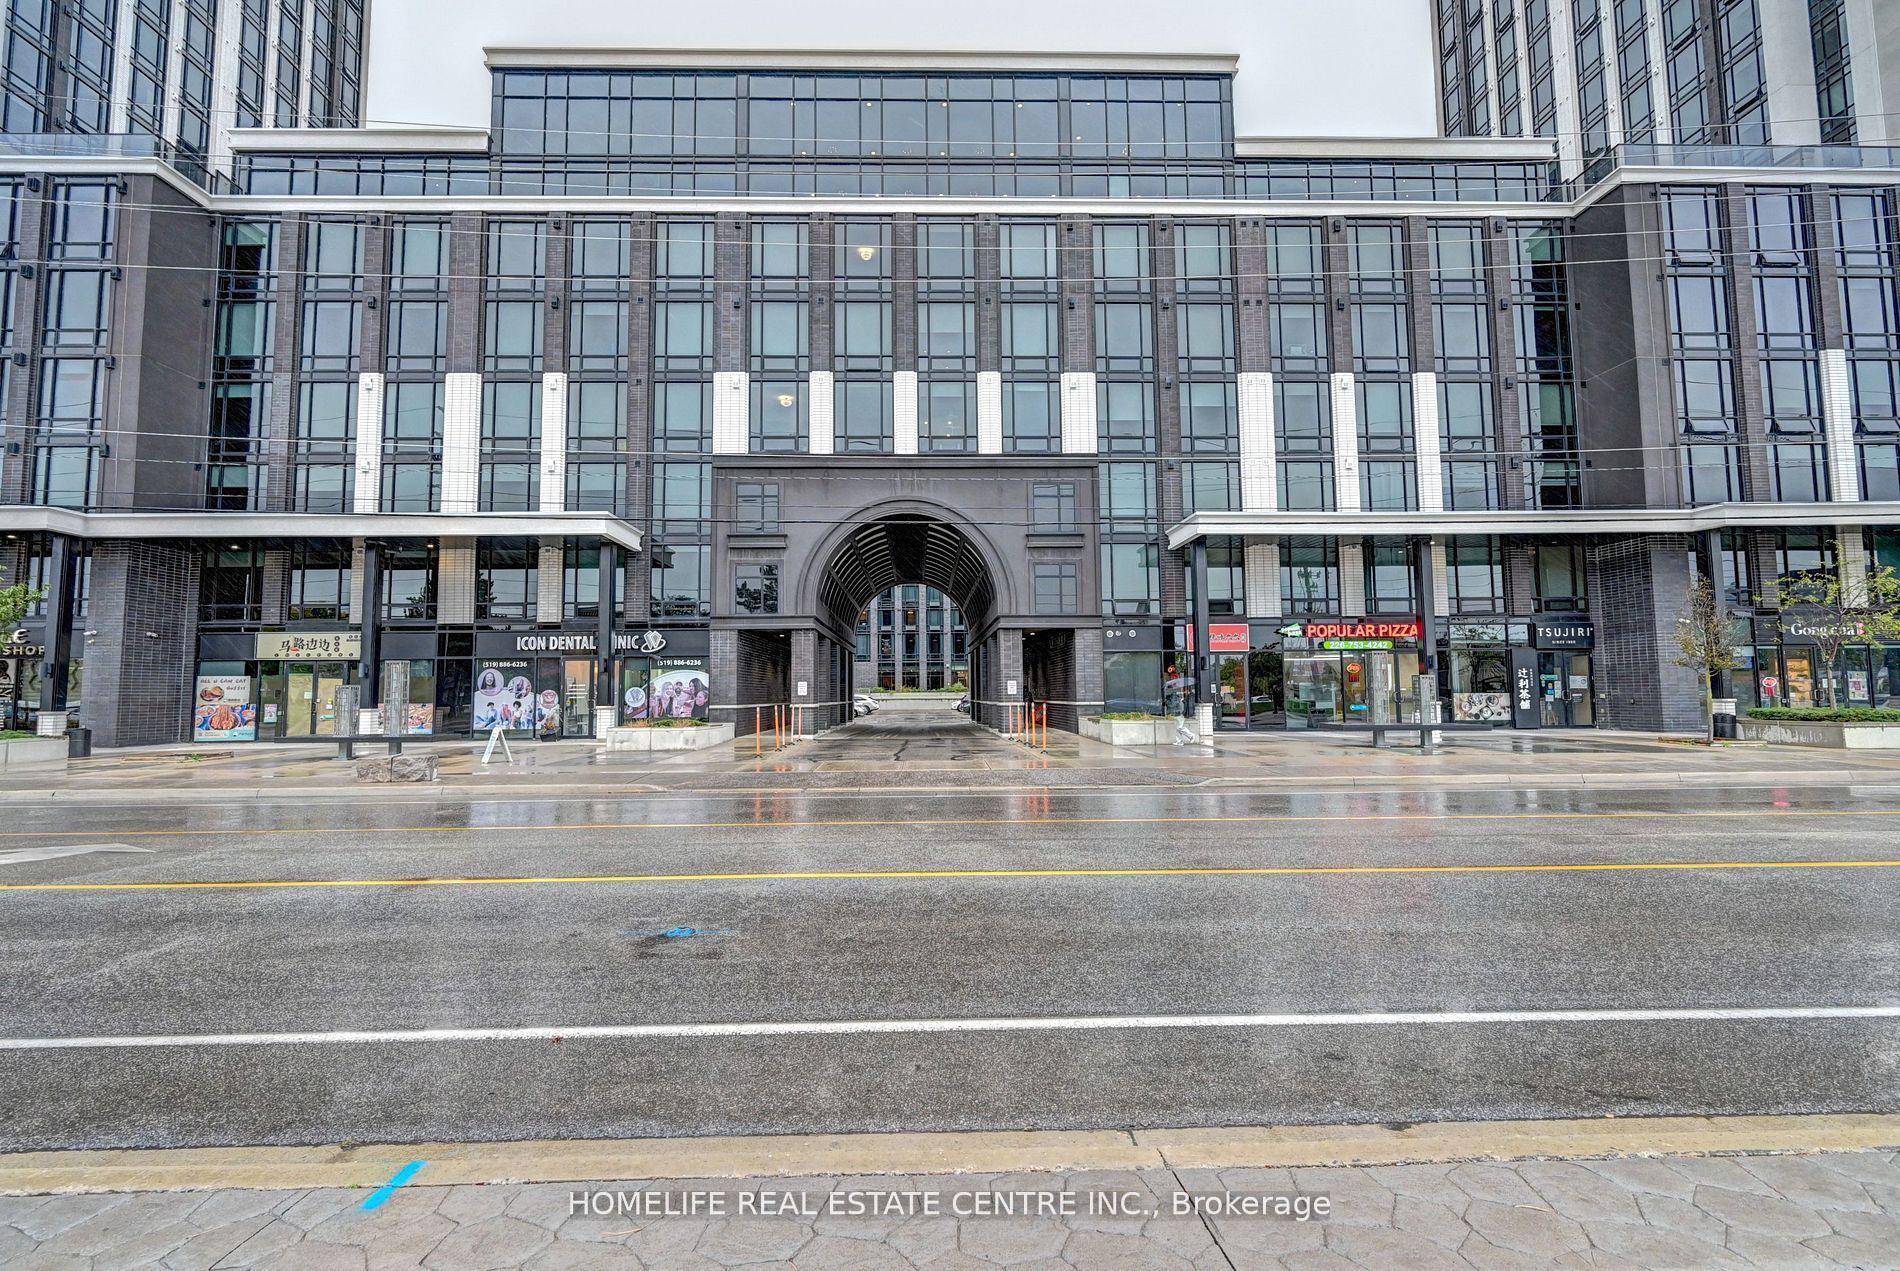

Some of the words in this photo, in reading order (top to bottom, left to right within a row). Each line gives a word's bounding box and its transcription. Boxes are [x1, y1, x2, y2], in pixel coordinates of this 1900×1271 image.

[1307, 624, 1375, 637] POPULAR
[1379, 624, 1418, 637] PIZZA
[1537, 627, 1590, 637] TSUJIRI
[1790, 623, 1828, 639] Gong
[279, 636, 331, 653] 马路边边
[516, 636, 547, 651] ICON
[549, 635, 597, 650] DENTAL
[656, 659, 673, 667] (519)
